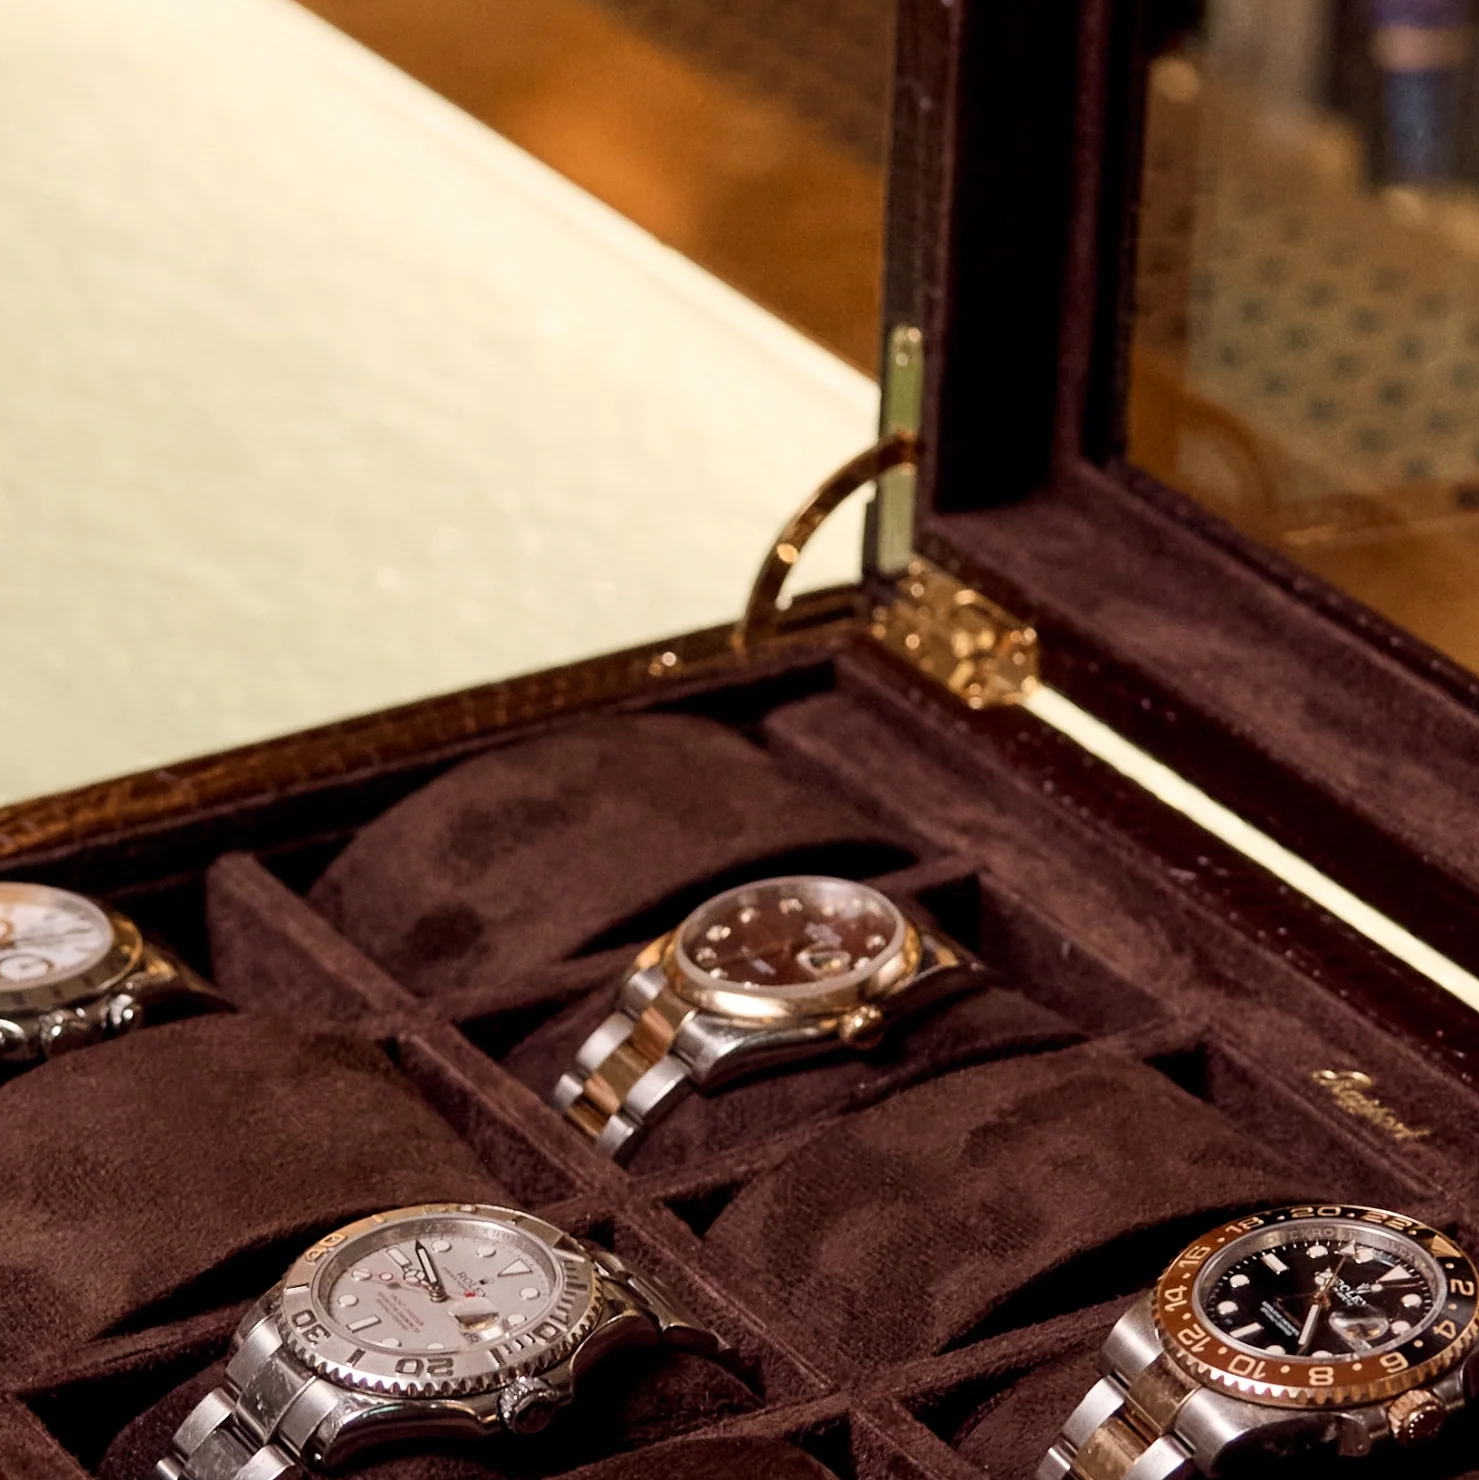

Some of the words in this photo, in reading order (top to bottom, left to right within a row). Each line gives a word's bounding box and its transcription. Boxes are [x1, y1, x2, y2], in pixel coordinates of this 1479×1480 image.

[1290, 1206, 1341, 1218] 20
[1362, 1211, 1413, 1231] 22
[1225, 1216, 1265, 1233] 18
[1177, 1245, 1212, 1268] 16
[1450, 1278, 1474, 1297] 2
[1164, 1285, 1188, 1312] 14
[291, 1309, 331, 1345] 30
[1432, 1320, 1457, 1339] 4
[1177, 1323, 1212, 1353] 12
[395, 1357, 454, 1378] 20
[1227, 1354, 1266, 1380] 10
[1379, 1351, 1409, 1374] 6
[1308, 1366, 1334, 1386] 8
